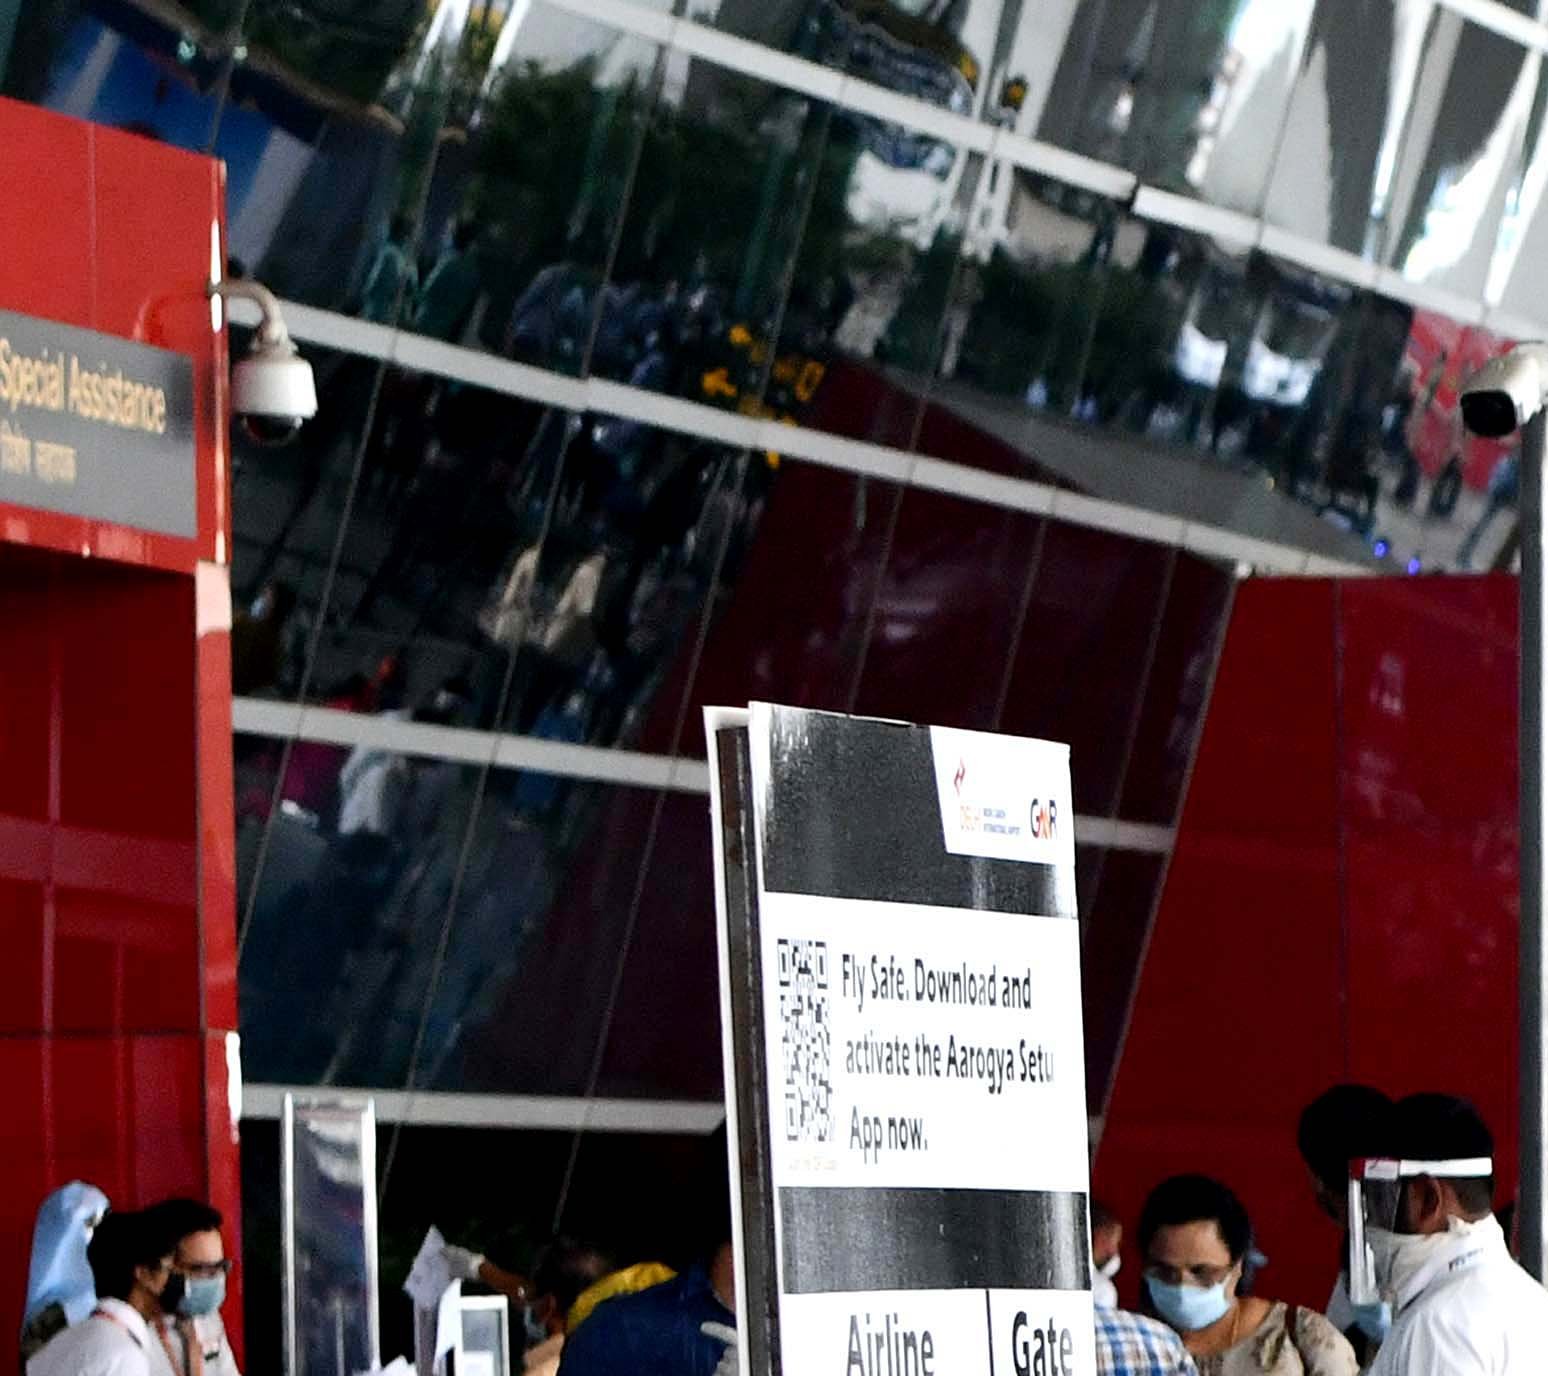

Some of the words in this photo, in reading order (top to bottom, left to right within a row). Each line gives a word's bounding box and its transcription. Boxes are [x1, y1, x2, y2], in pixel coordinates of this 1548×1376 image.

[68, 353, 166, 434] Assistance
[842, 954, 866, 1013] Fly
[871, 954, 910, 1001] Safe.
[914, 960, 997, 1007] Download
[1002, 968, 1032, 1010] and
[846, 1030, 910, 1076] activate
[914, 1033, 941, 1077] the
[947, 1035, 1015, 1094] Aarogya
[1019, 1038, 1055, 1083] Setu
[850, 1105, 882, 1164] App
[888, 1116, 929, 1151] now.
